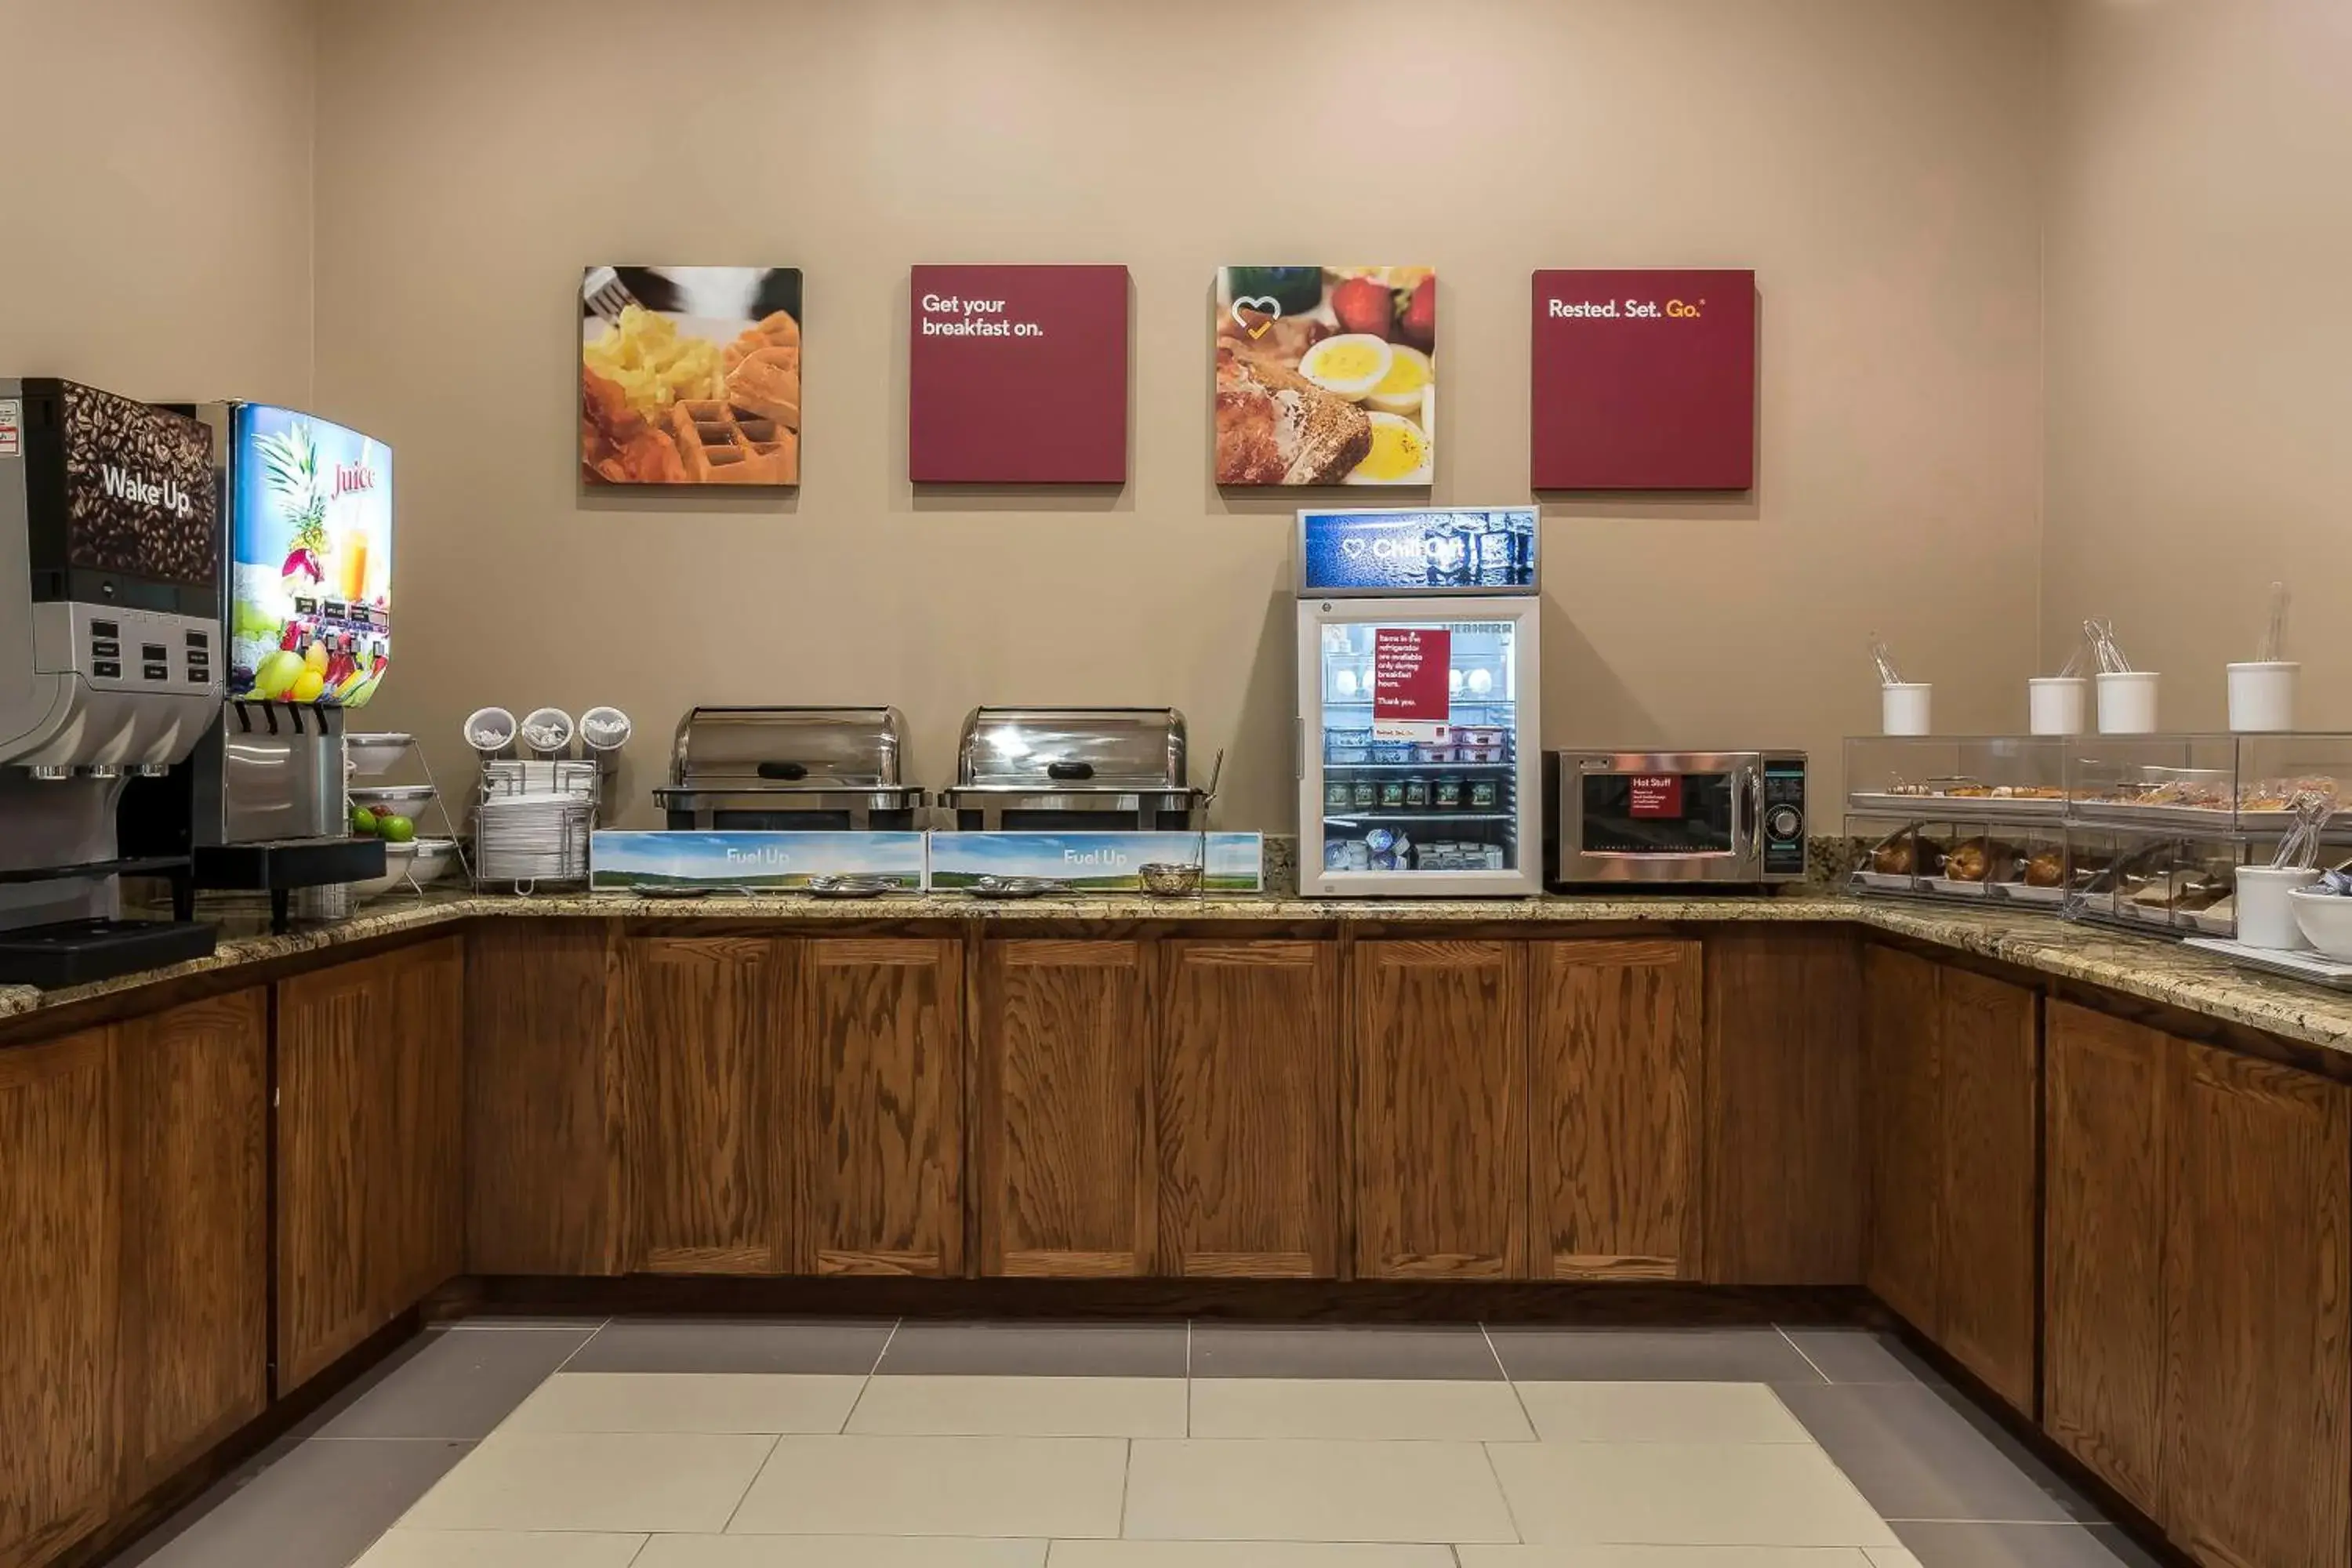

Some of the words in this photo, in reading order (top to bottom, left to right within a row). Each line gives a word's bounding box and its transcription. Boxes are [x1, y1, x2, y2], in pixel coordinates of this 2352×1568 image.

[922, 294, 959, 313] Get
[964, 298, 1005, 316] your
[1548, 299, 1621, 318] Rested.
[1624, 299, 1661, 318] Set.
[922, 317, 1011, 336] breakfast
[1014, 322, 1044, 336] on.
[102, 463, 160, 506] Wake
[163, 479, 190, 518] Up
[331, 460, 376, 501] Juice
[727, 847, 762, 866] Fuel
[766, 848, 790, 868] Up
[1064, 848, 1100, 866] Fuel
[1103, 848, 1127, 868] Up
